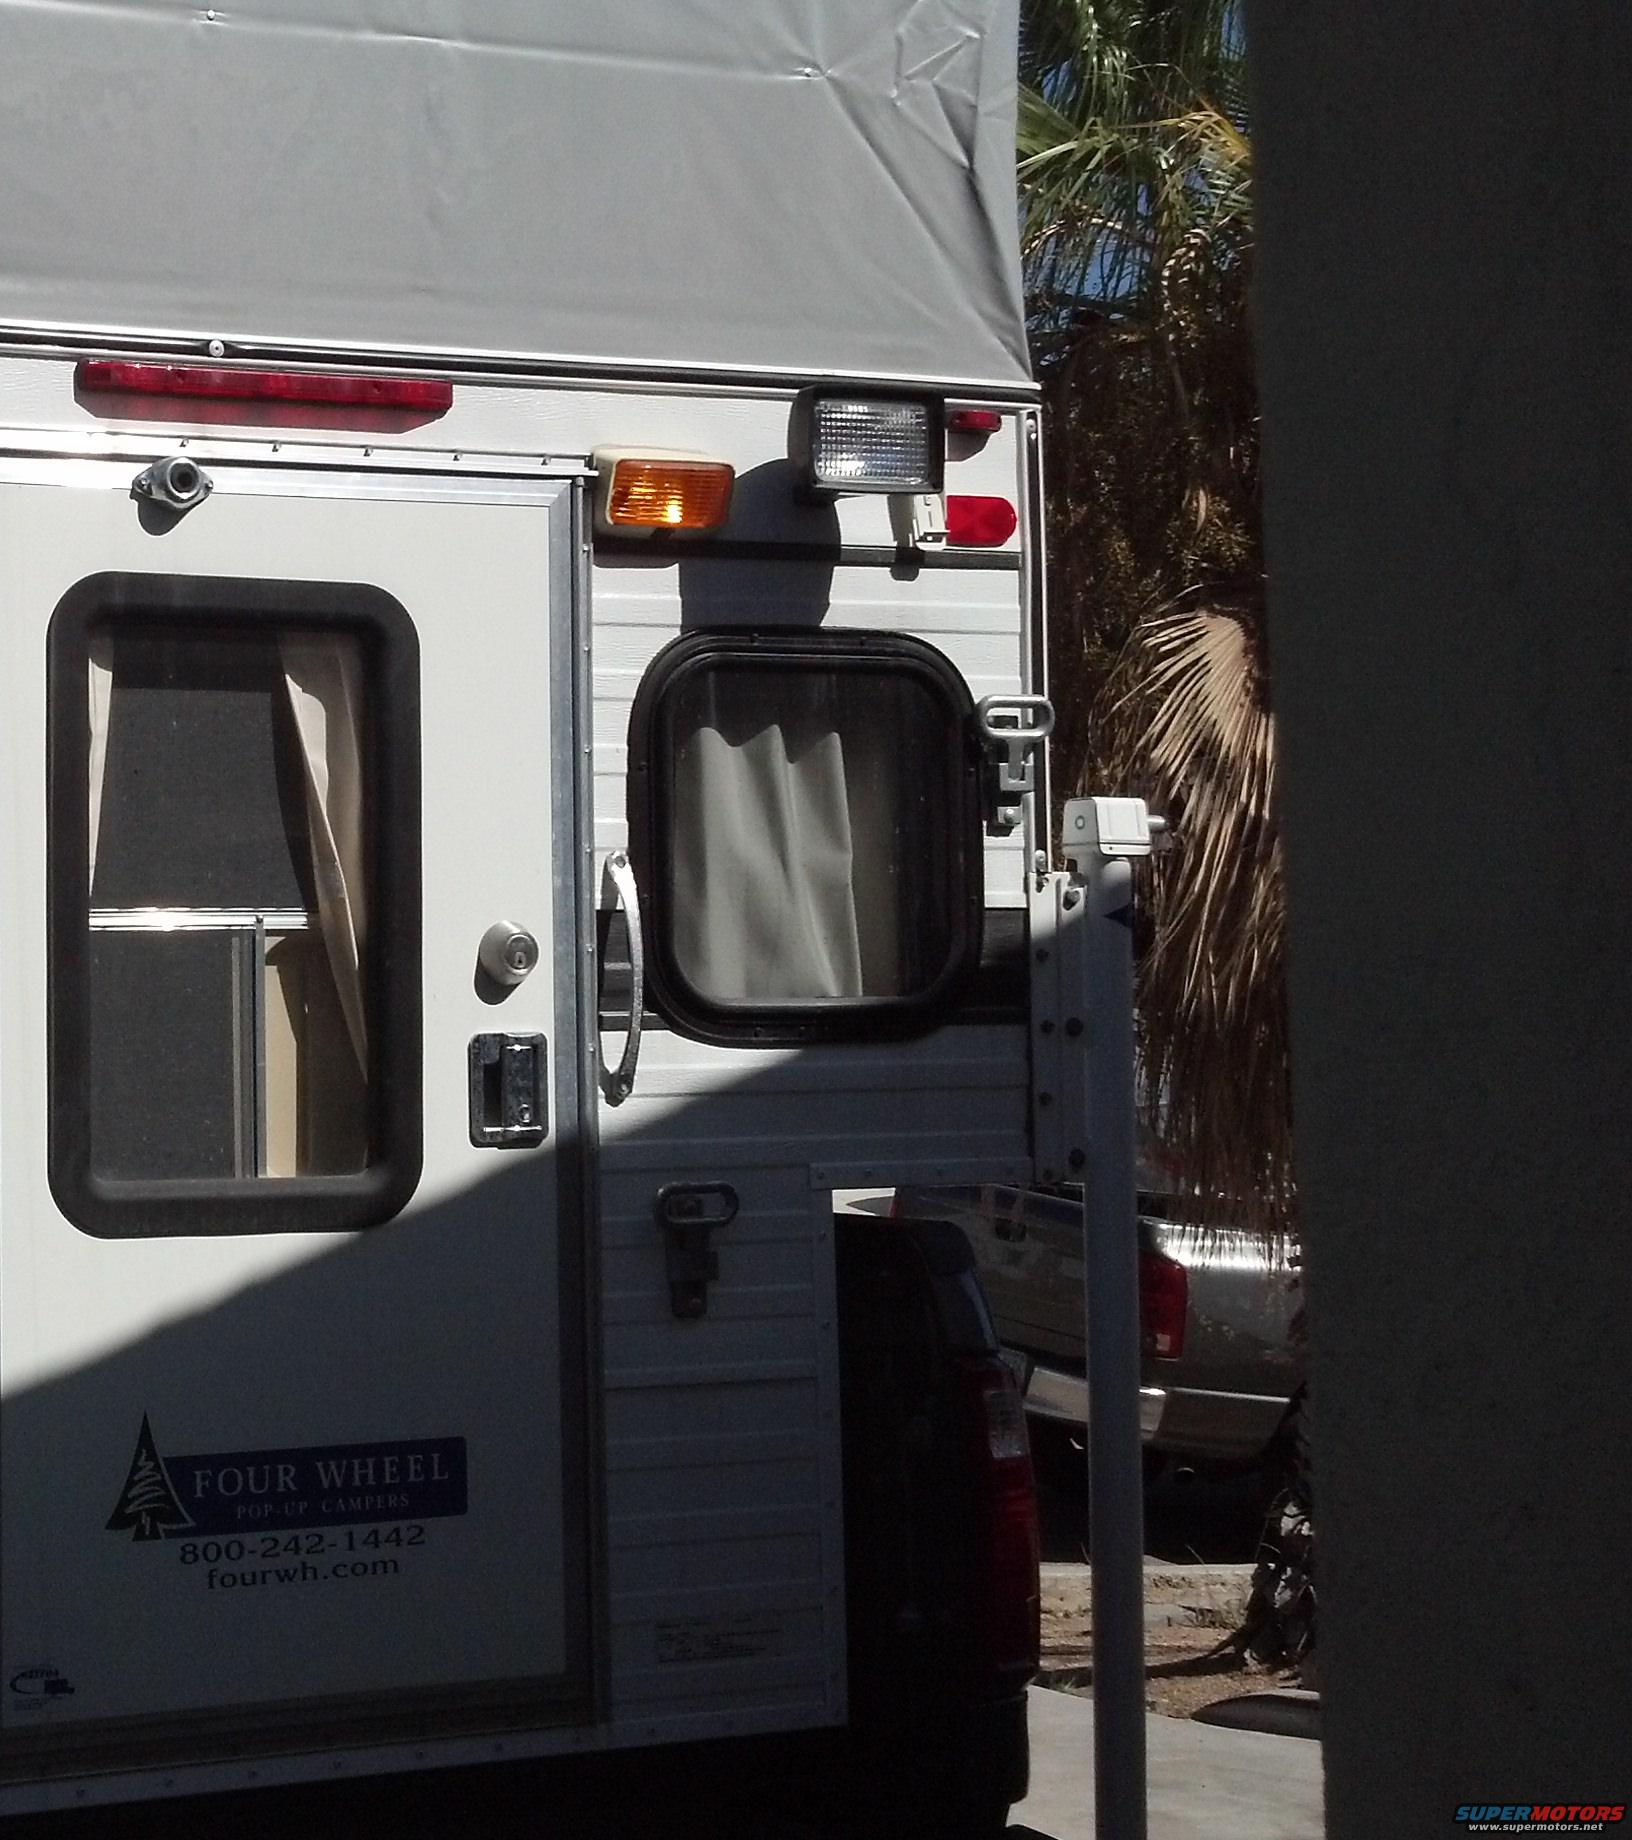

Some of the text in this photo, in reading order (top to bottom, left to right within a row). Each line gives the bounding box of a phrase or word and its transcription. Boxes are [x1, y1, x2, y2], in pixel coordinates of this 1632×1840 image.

[193, 1452, 450, 1498] FOUR WHEEL
[236, 1493, 410, 1520] POP-UP CAMPERS
[179, 1524, 427, 1566] 800-242-1442
[206, 1557, 400, 1590] fourwh.com
